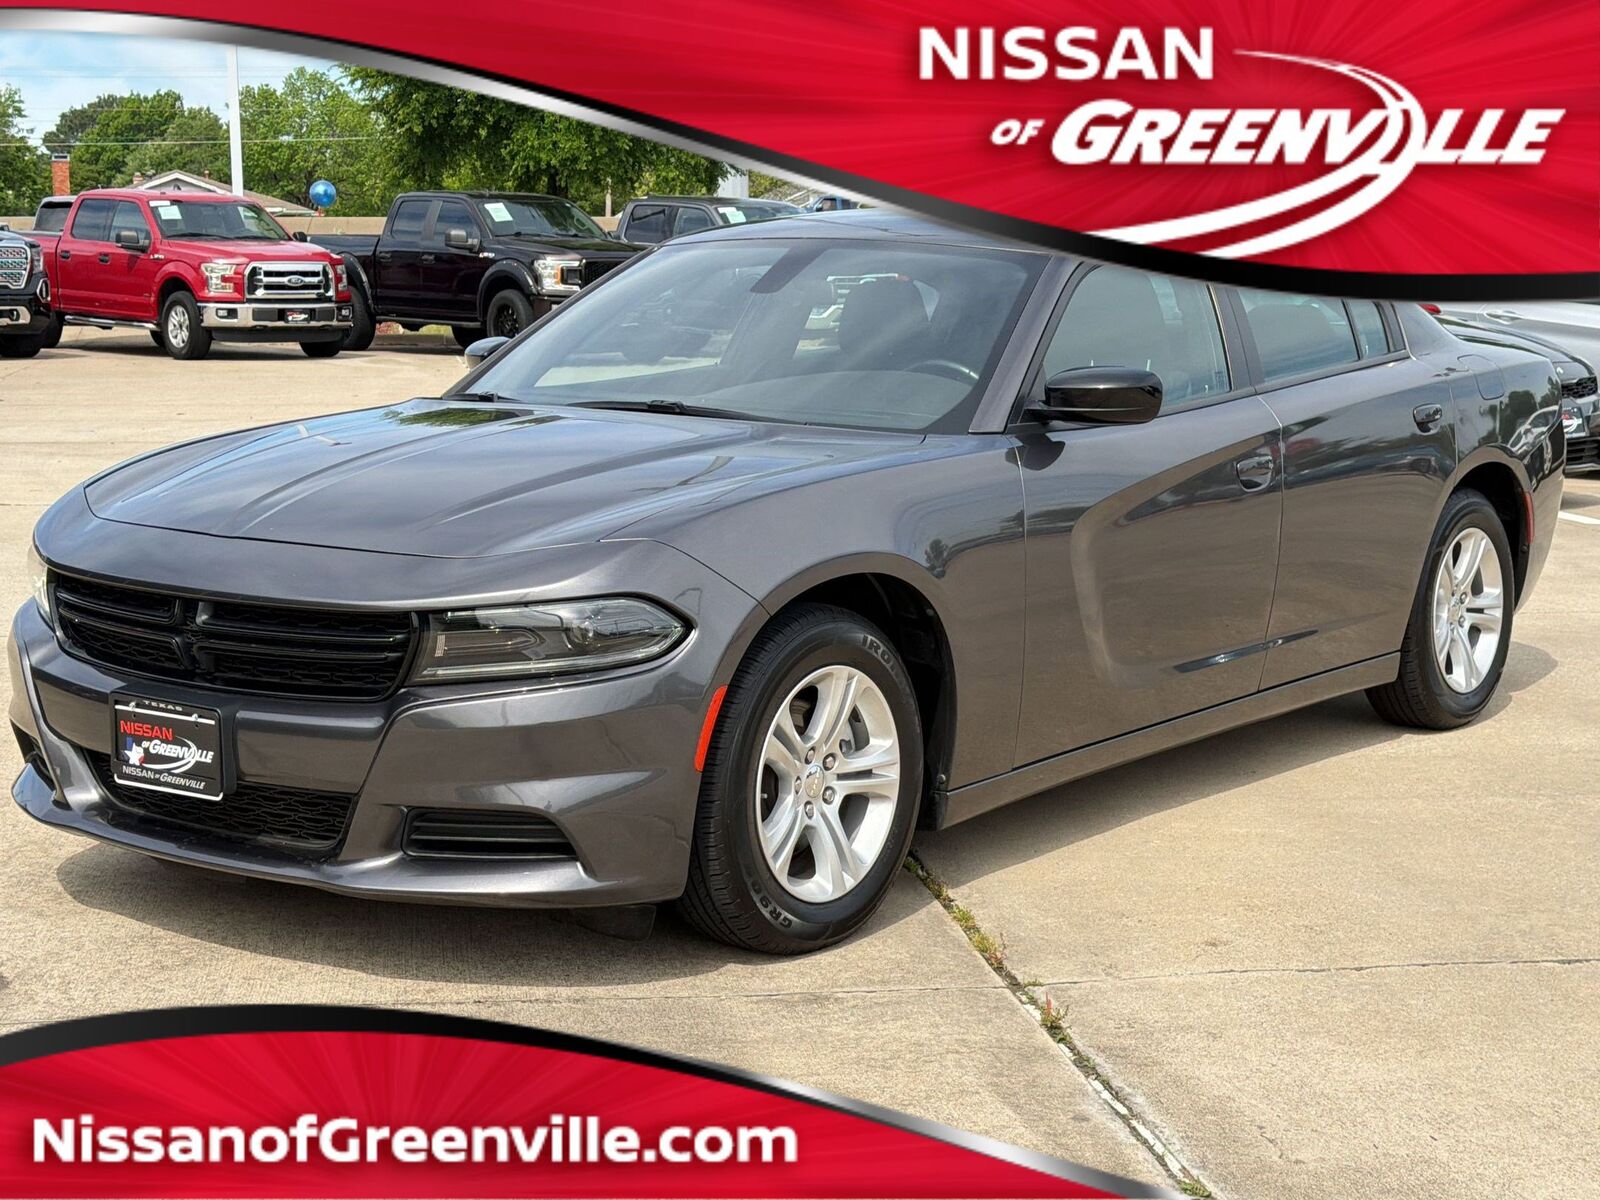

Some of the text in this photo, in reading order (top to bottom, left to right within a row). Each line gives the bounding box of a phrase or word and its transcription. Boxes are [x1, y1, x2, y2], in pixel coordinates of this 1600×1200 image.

[143, 700, 183, 712] TEXAS
[120, 720, 174, 741] NISSAN
[122, 765, 154, 779] NISSAN
[160, 773, 206, 790] GREENVILLE
